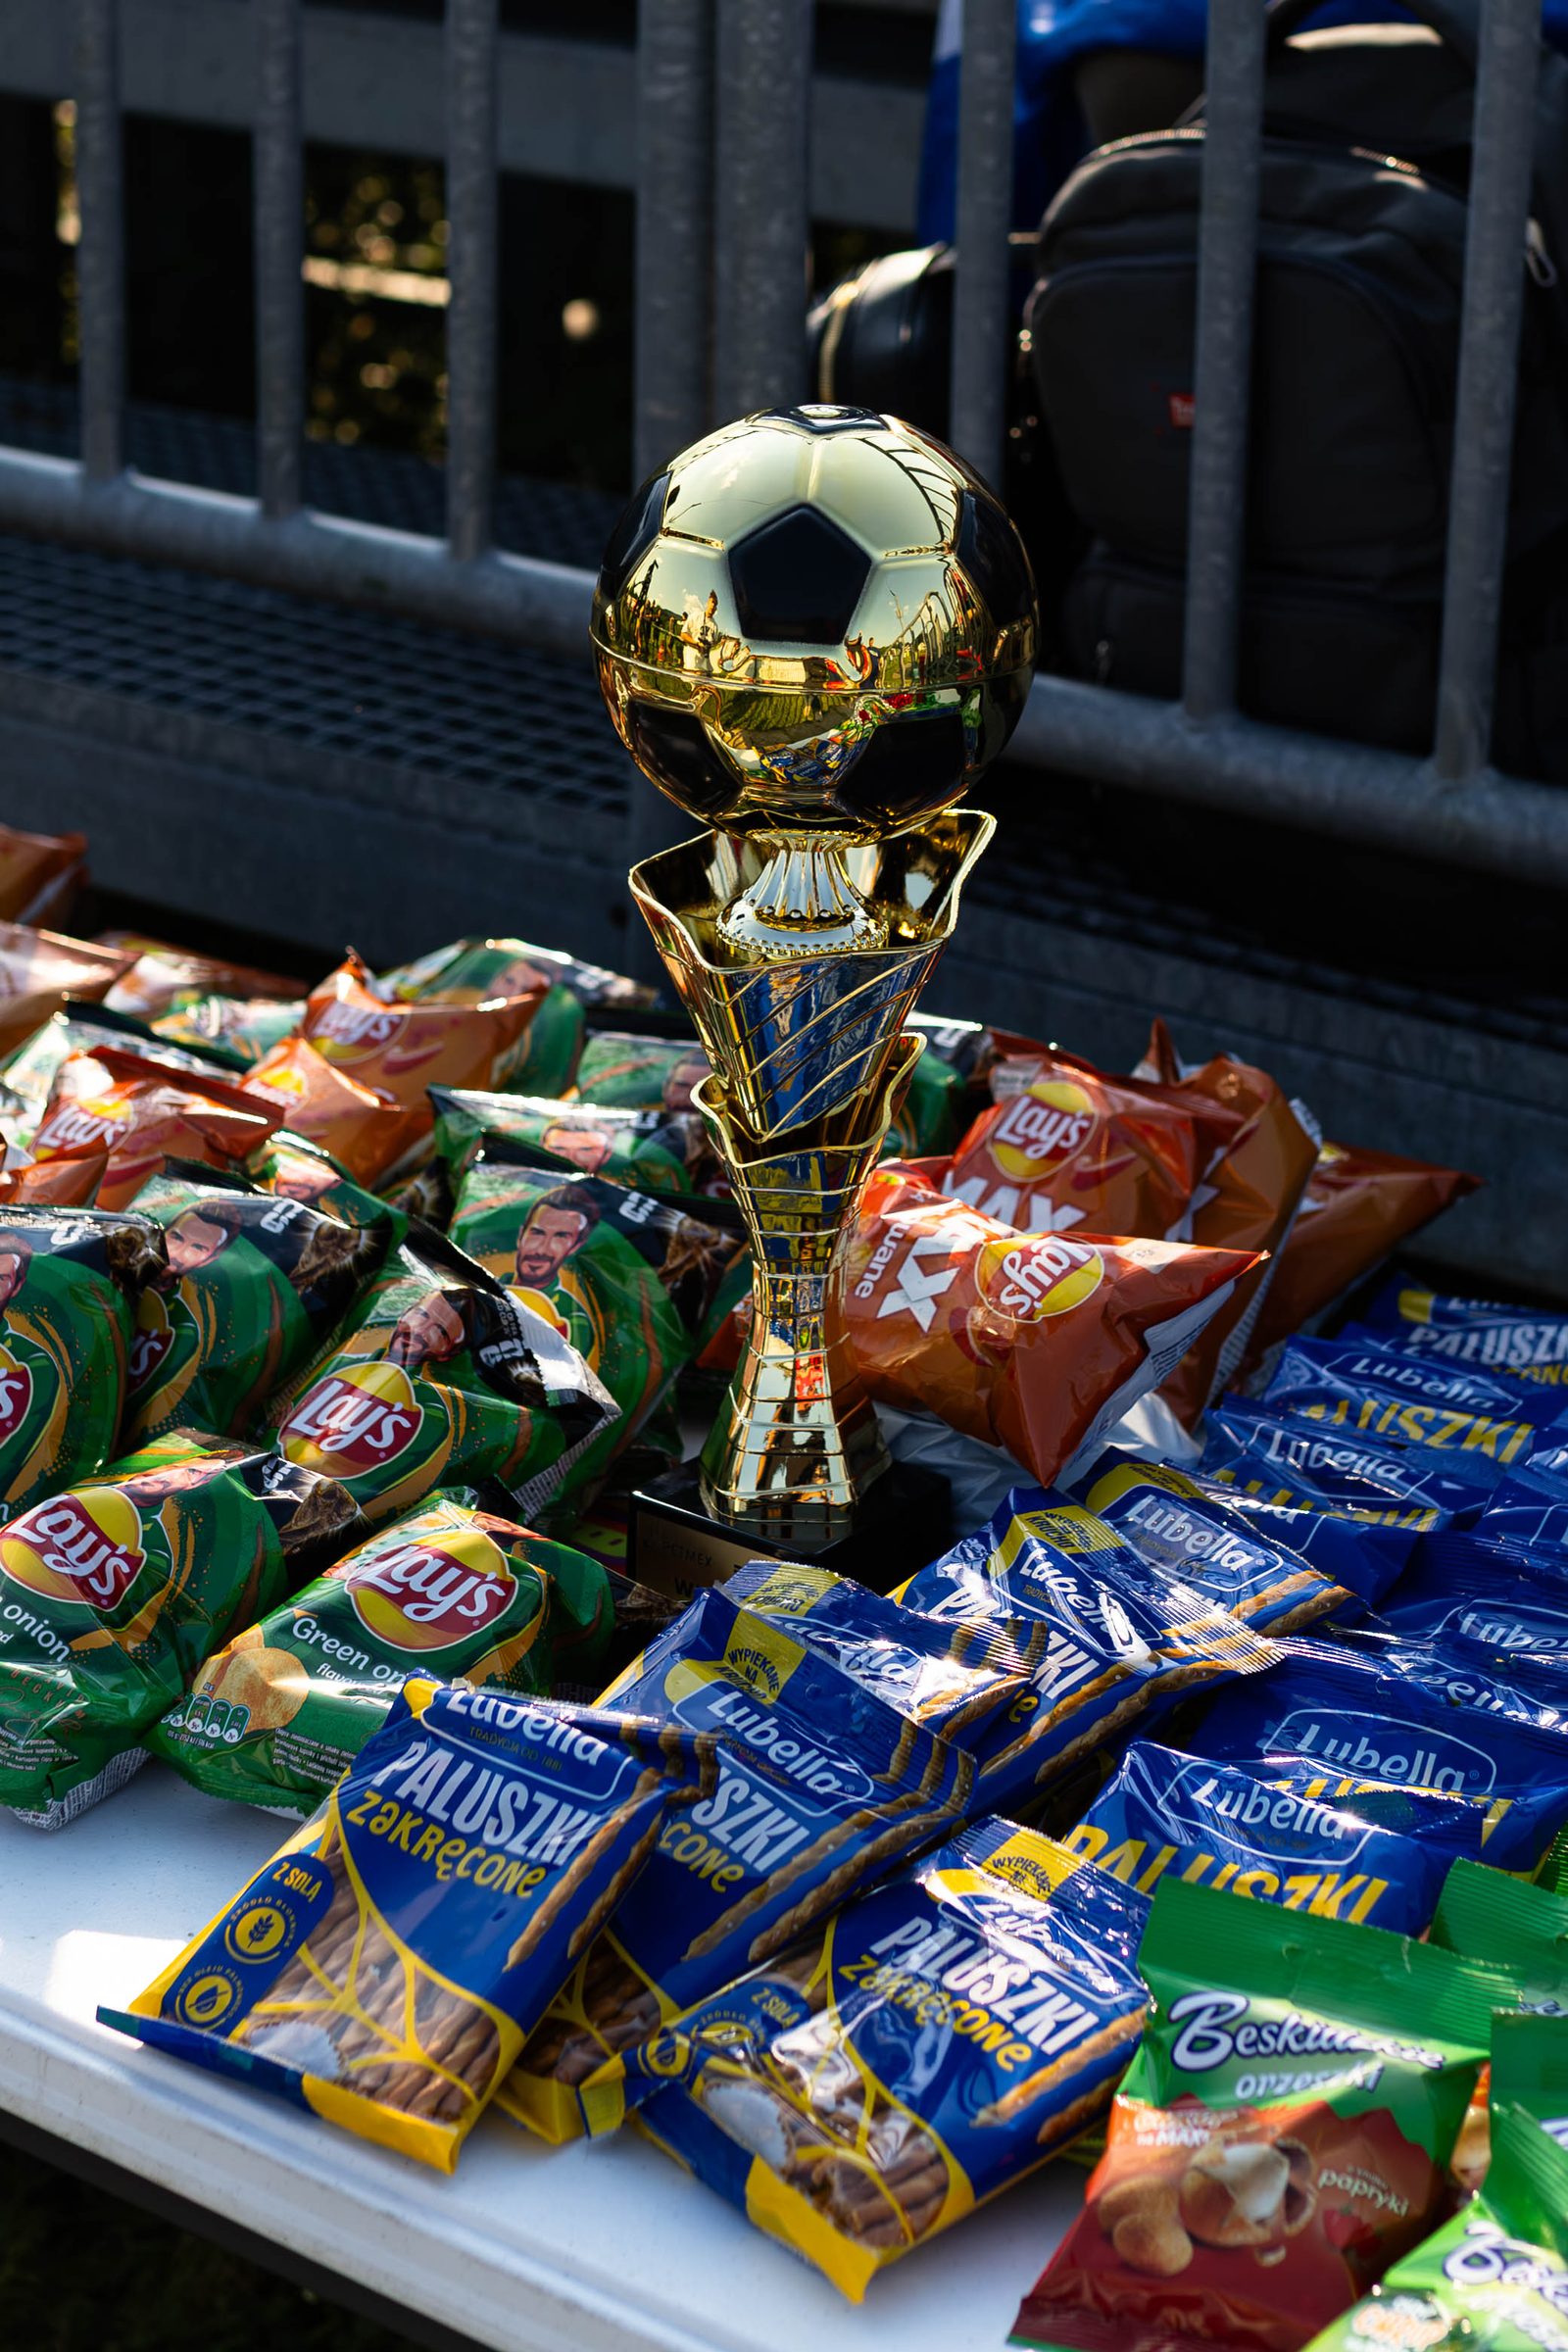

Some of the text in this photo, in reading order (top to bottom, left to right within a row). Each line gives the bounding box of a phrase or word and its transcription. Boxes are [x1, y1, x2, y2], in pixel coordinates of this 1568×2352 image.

[995, 1095, 1090, 1159] Lay's
[1351, 1357, 1495, 1409] Lubella
[287, 1379, 412, 1452] Lay's
[4, 1494, 130, 1596] Lay's
[1126, 1494, 1254, 1573] Lubella
[357, 1545, 506, 1622] Lay's
[4, 1603, 72, 1663] onion
[292, 1617, 369, 1671] Green
[728, 1647, 780, 1693] WYPIEKANE
[745, 1667, 759, 1683] NA
[707, 1690, 842, 1794] Lubella
[1297, 1724, 1465, 1791] Lubella
[371, 1740, 601, 1866] PALUSZKI
[1190, 1778, 1347, 1839] Lubella
[272, 1861, 288, 1883] Z
[870, 1916, 1100, 2055] PALUSZKI
[1318, 2169, 1410, 2218] papryki
